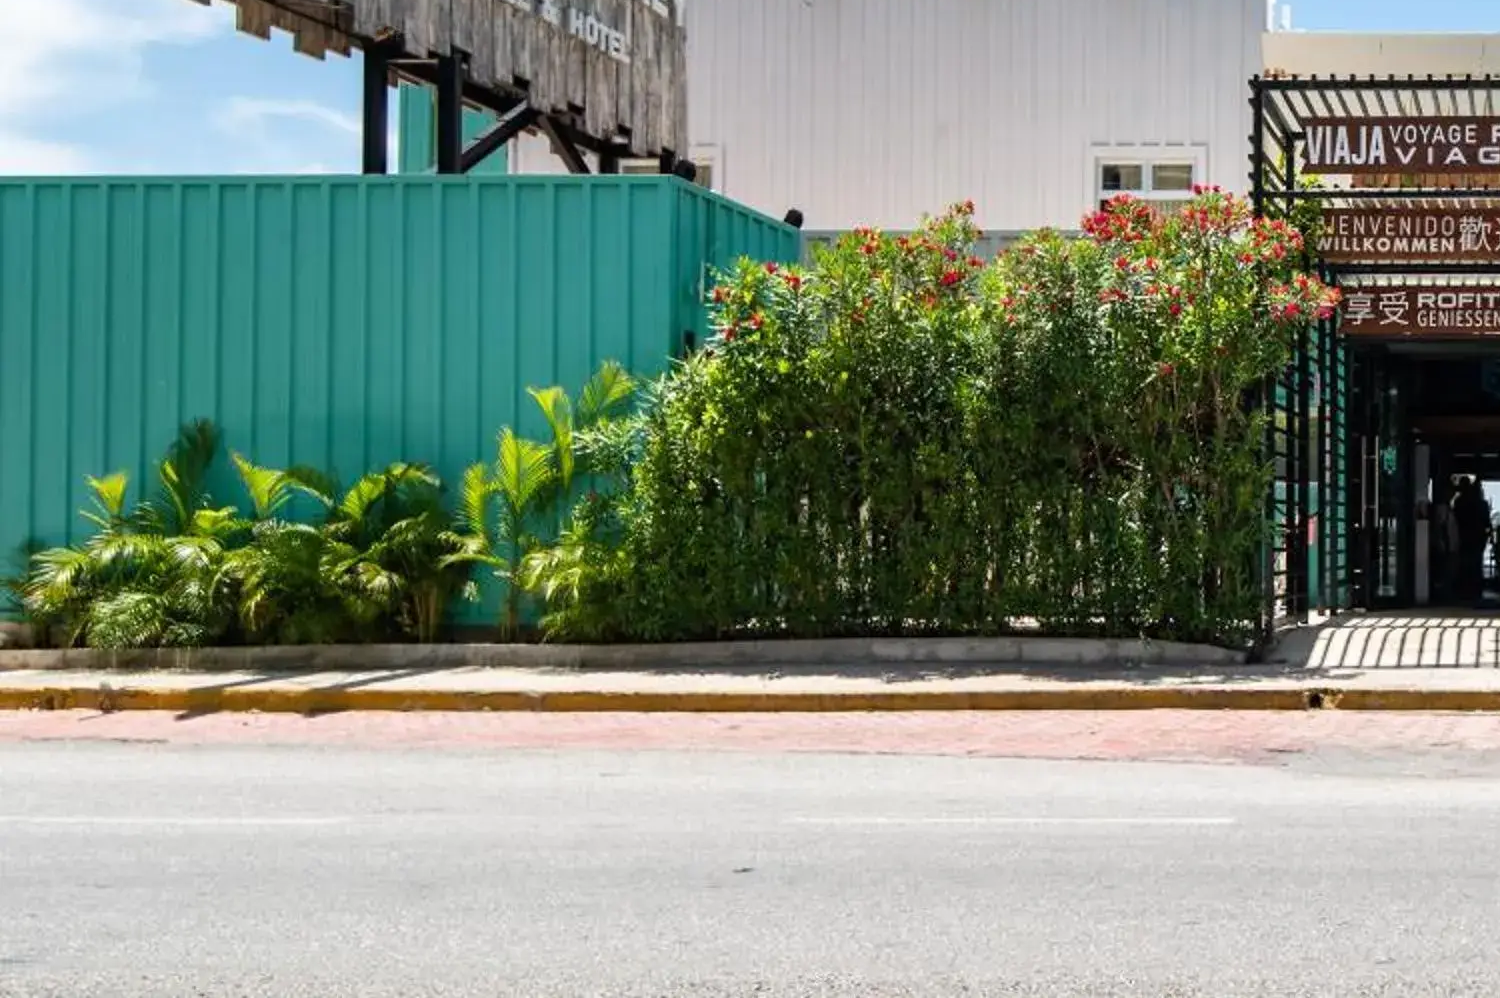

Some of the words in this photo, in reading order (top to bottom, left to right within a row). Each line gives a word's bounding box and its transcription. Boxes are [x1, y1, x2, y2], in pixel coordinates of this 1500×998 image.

[568, 8, 631, 64] HOTEL
[1306, 125, 1387, 165] VIAJA
[1389, 125, 1477, 144] VOYAGE
[1315, 237, 1455, 252] WILLKOMMEN
[1344, 291, 1409, 326] 享受
